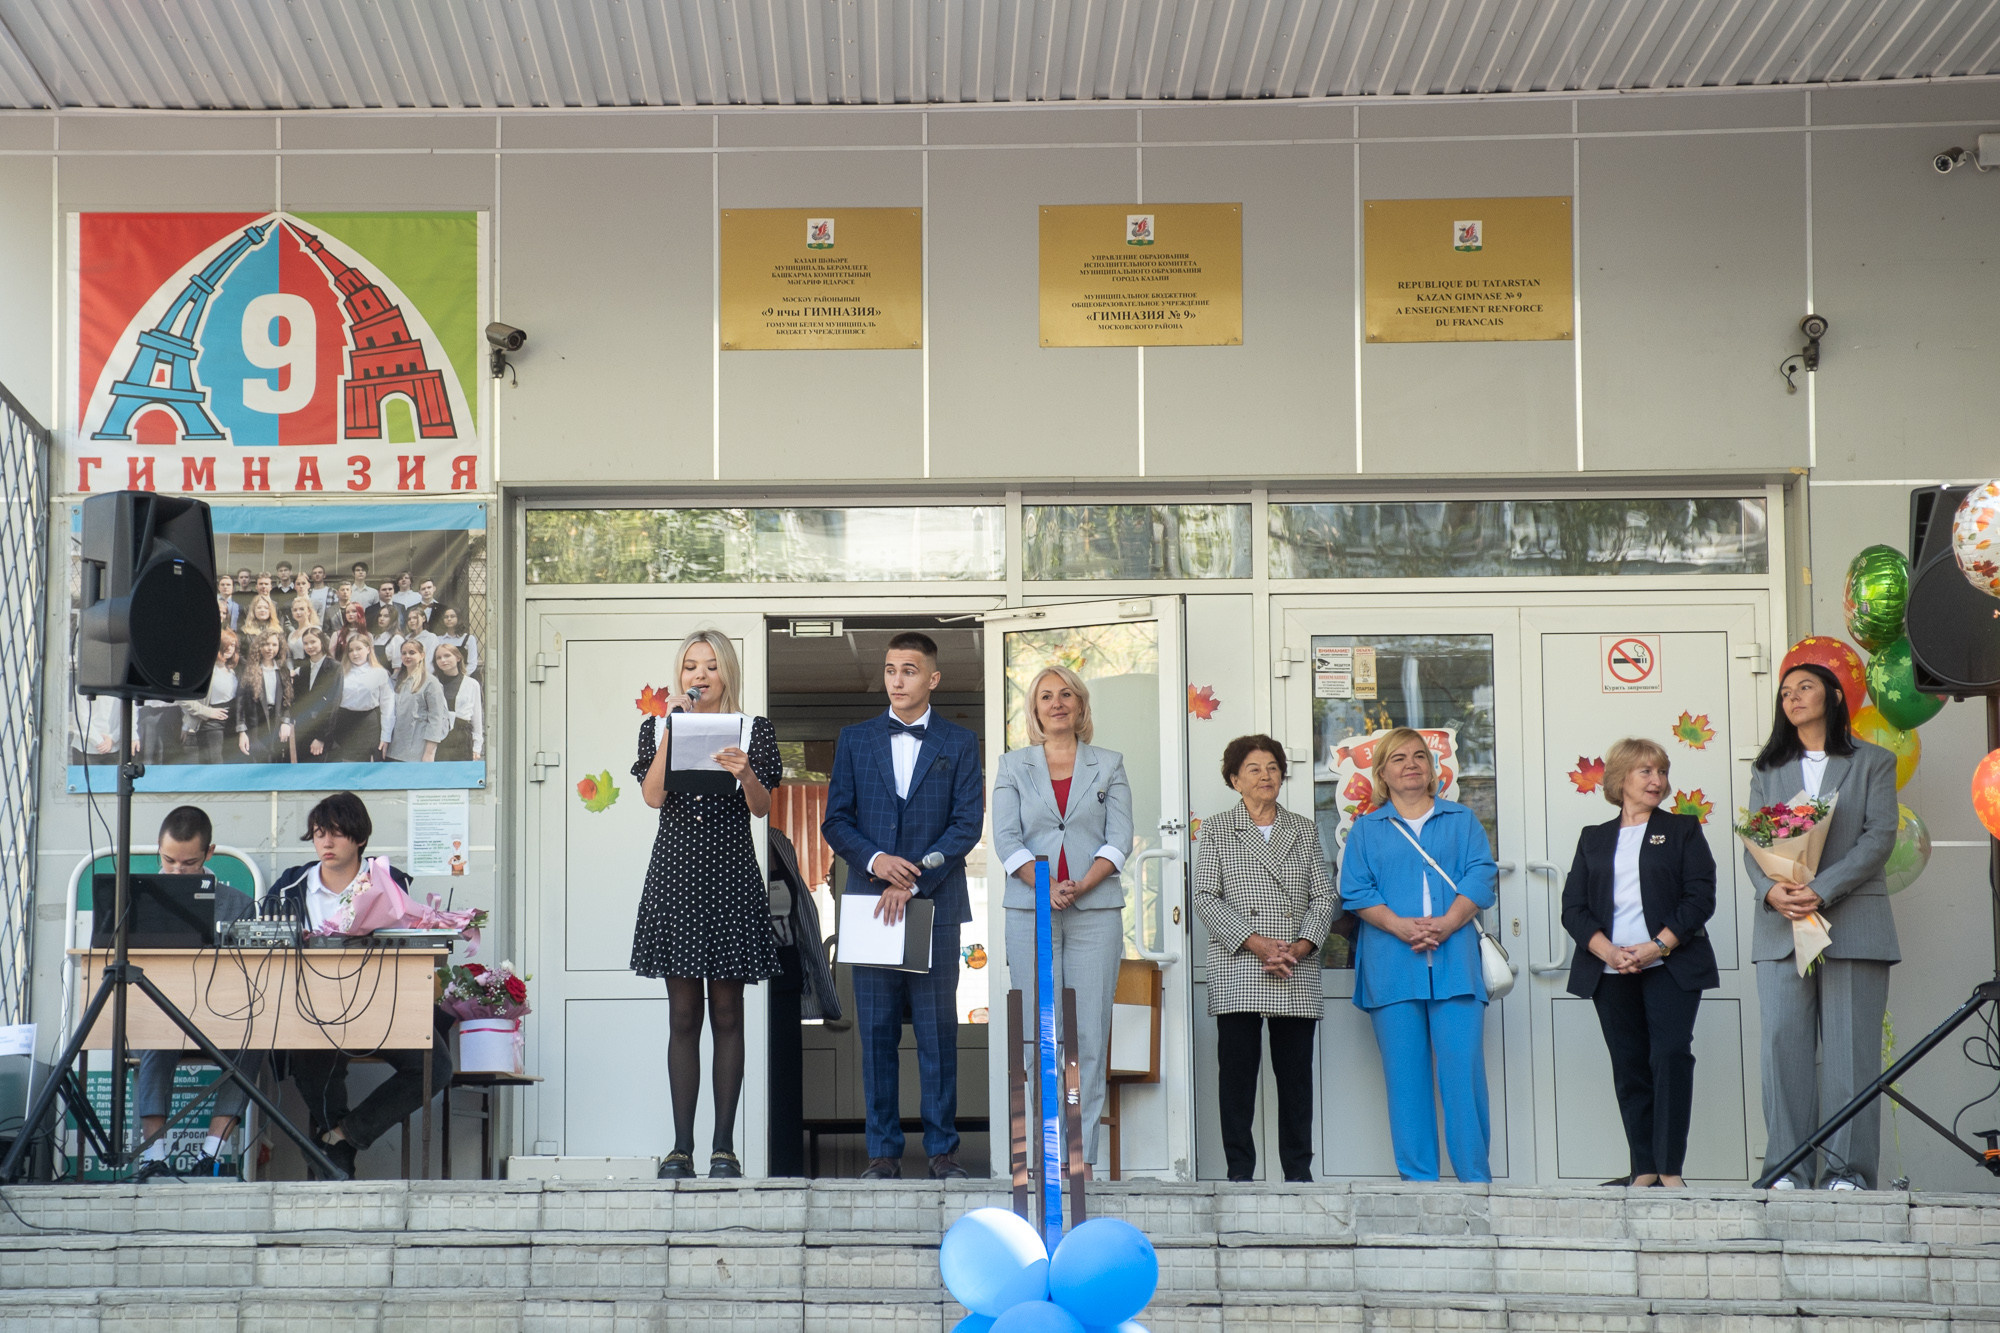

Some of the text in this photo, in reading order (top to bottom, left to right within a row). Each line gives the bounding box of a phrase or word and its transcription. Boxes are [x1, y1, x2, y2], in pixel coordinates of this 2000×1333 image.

[1398, 279, 1540, 289] REPUBLIQUE DU TATARSTAN
[1455, 292, 1502, 301] GIMNASE
[761, 307, 773, 317] «9
[804, 307, 882, 317] ГИМНАЗИЯ»
[1405, 306, 1485, 314] ENSEIGNEMENT
[1488, 304, 1543, 313] RENFORCE
[1086, 310, 1196, 321] «ГИМНАЗИЯ № 9»
[1453, 318, 1504, 326] FRANCAIS
[241, 293, 317, 415] 9
[78, 455, 478, 492] ГИМНАЗИЯ
